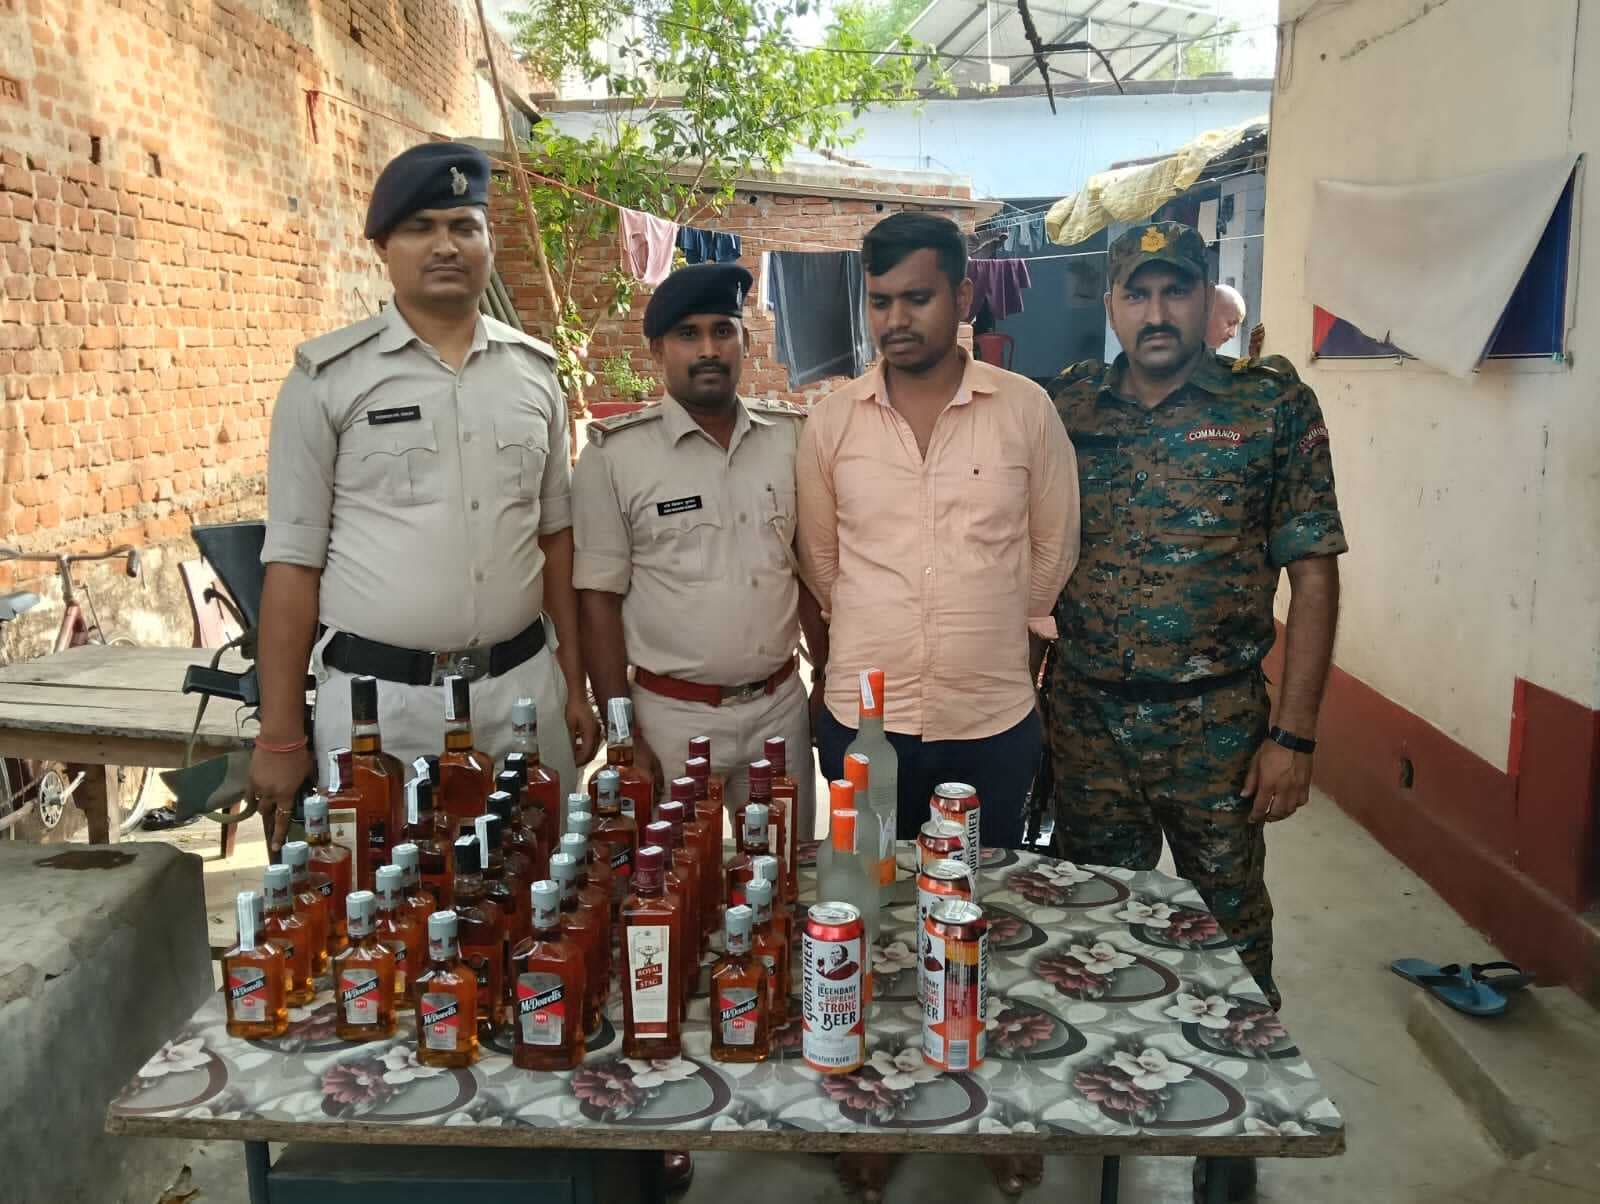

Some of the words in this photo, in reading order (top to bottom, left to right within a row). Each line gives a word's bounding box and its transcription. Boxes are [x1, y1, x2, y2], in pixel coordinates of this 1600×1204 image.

[1188, 428, 1241, 441] COMMANDO
[637, 965, 660, 977] ROYAL
[639, 979, 659, 989] STAG
[803, 938, 817, 1022] GODFATHER
[817, 984, 857, 997] LEGENDARY
[818, 1001, 857, 1013] STRONG
[821, 1011, 857, 1031] BEER
